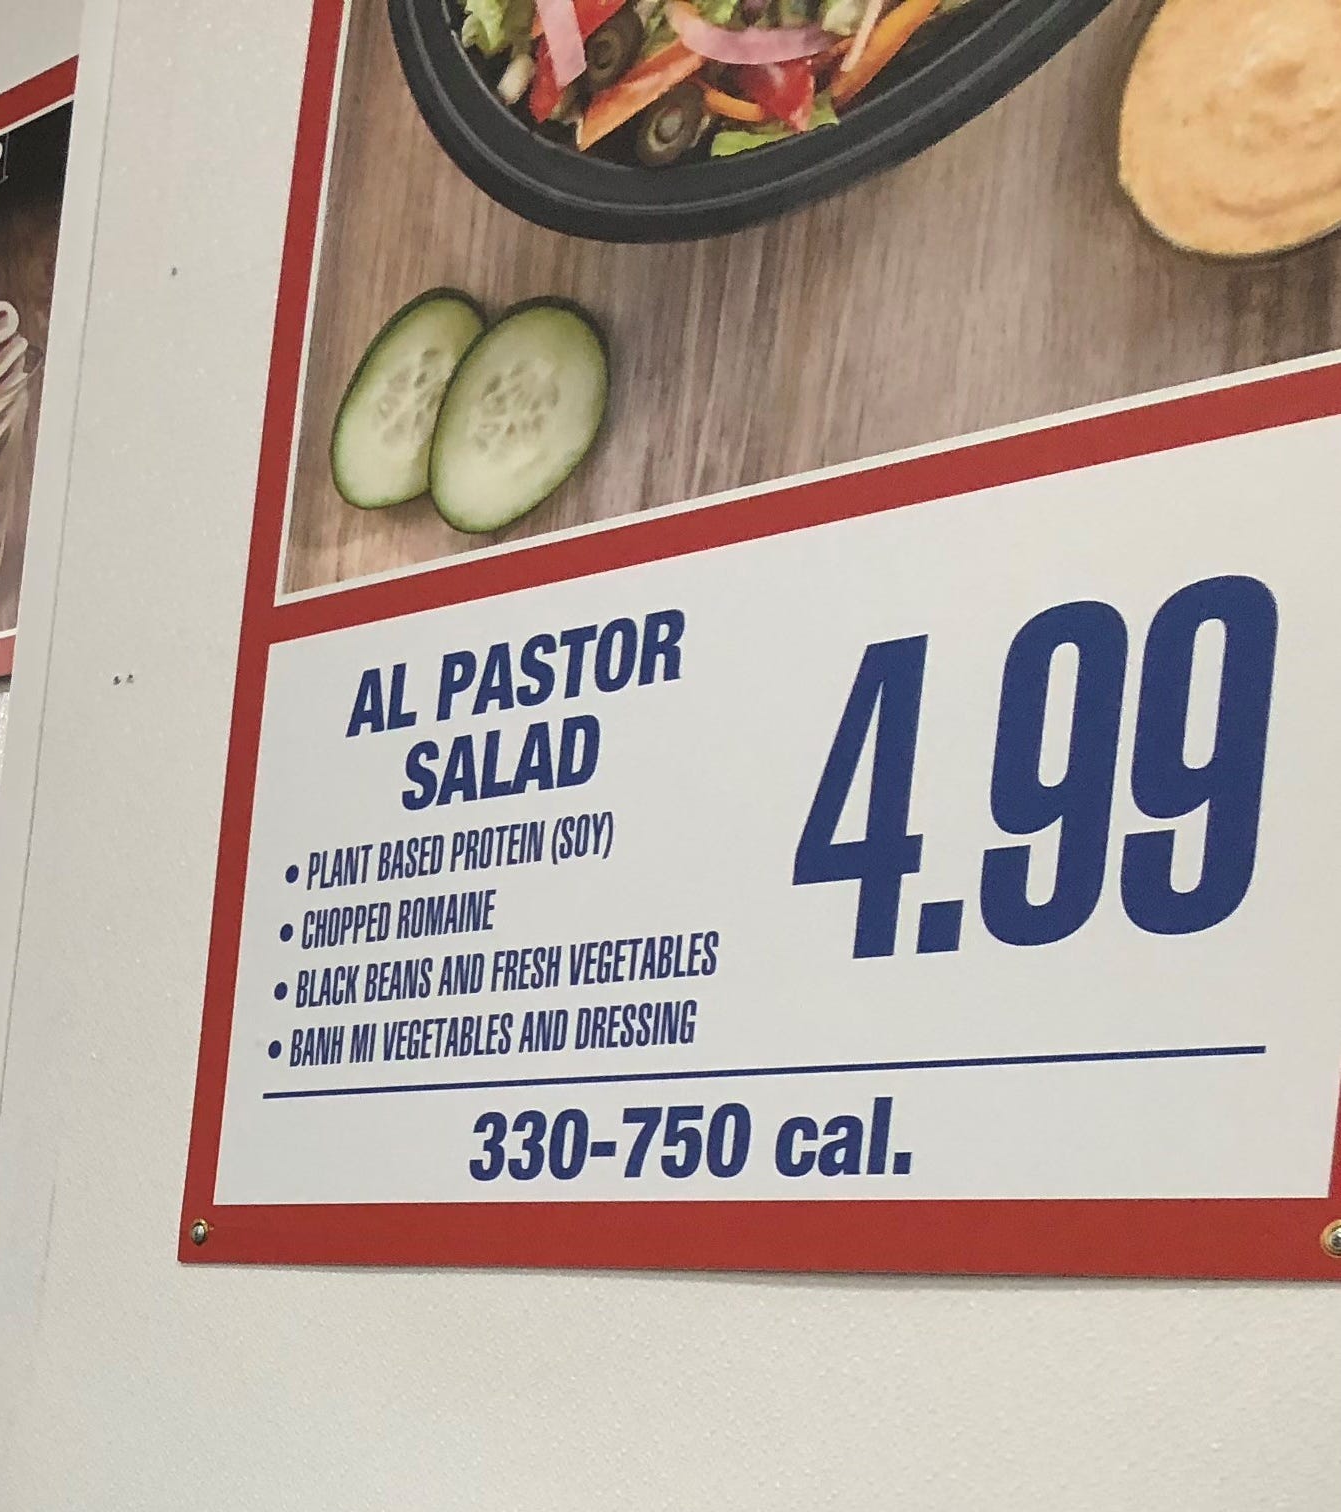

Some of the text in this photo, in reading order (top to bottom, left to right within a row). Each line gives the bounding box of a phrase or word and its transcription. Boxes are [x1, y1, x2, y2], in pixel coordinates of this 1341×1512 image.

[347, 610, 685, 737] AL PASTOR
[402, 715, 600, 810] SALAD
[794, 576, 1278, 958] 4.99
[308, 811, 615, 890] PLANT BASED PROTEIN (SOY)
[302, 890, 495, 949] CHOPPED ROMAINE
[297, 932, 719, 1007] BLACK BEANS AND FRESH VEGETABLES
[291, 1001, 697, 1067] BANH MI VEGETABLES AND DRESSING
[470, 1097, 911, 1181] 330-750 cal.
